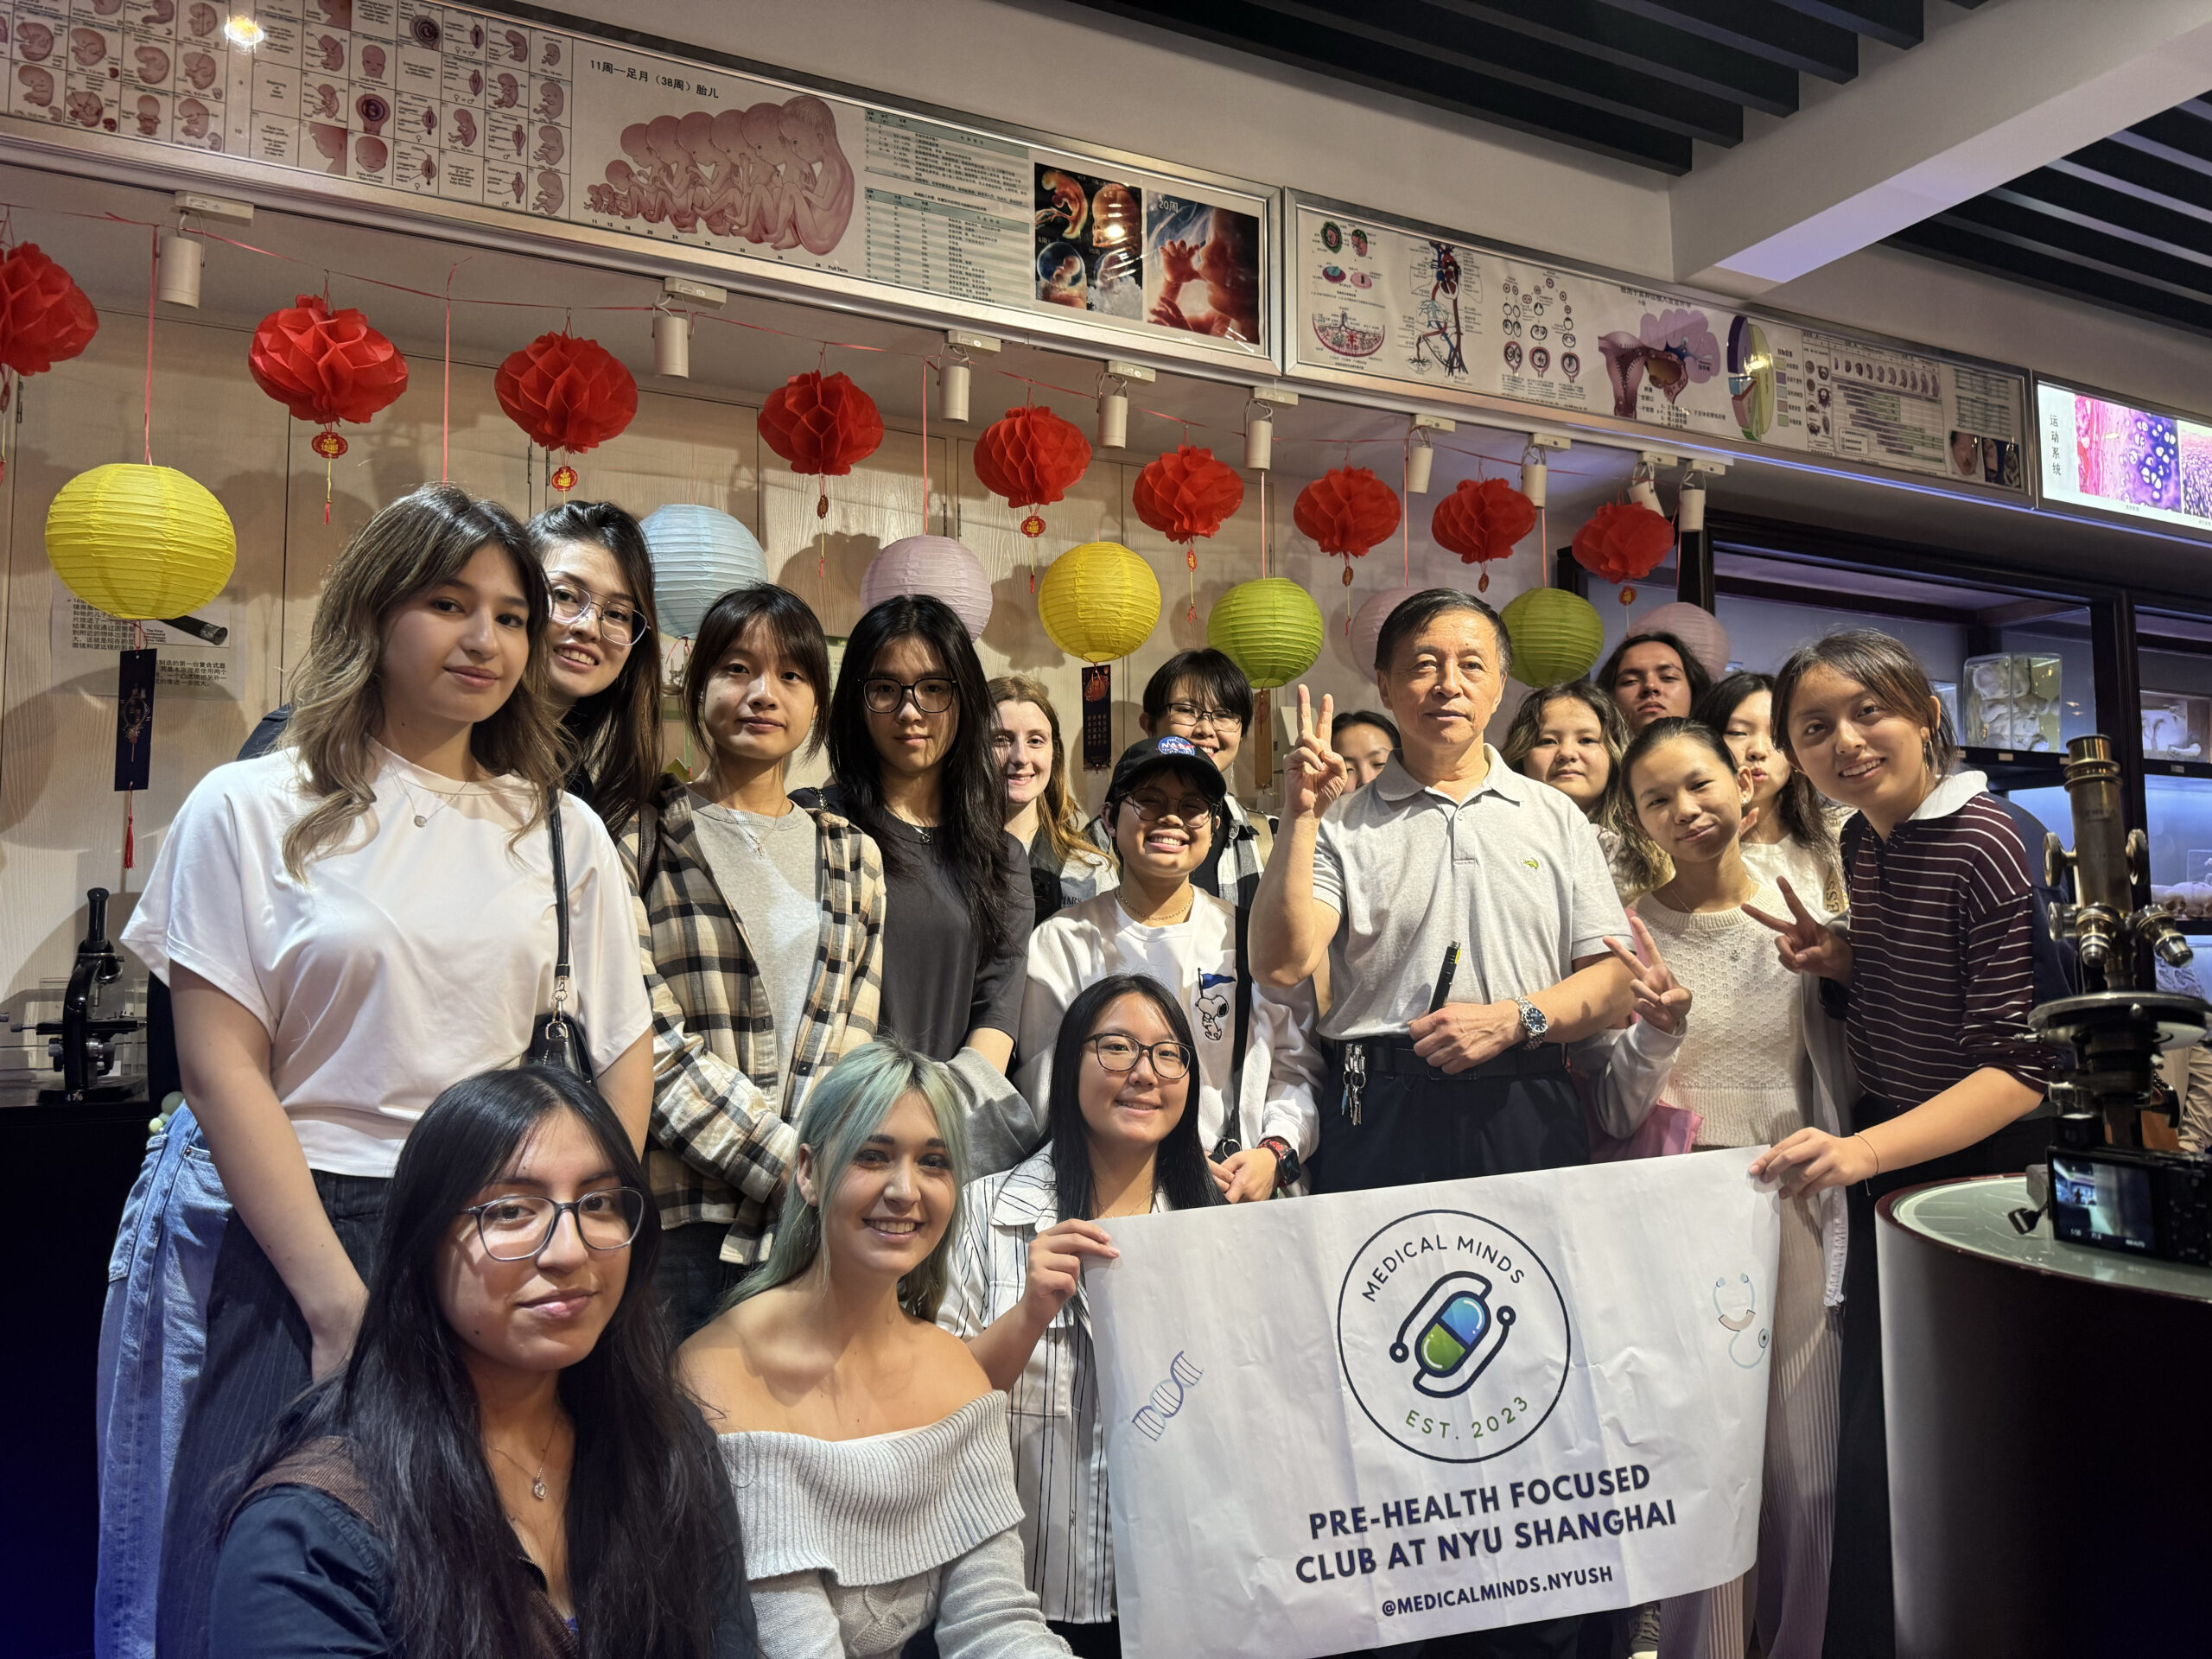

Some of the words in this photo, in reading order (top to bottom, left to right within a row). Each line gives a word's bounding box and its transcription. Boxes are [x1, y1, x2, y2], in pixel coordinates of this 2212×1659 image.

[2050, 414, 2062, 476] 运动系统
[1161, 741, 1192, 753] NASA
[1362, 1234, 1447, 1302] MEDICAL
[1458, 1236, 1524, 1284] MINDS
[1405, 1409, 1459, 1440] EST.
[1471, 1396, 1528, 1439] 2023
[1308, 1485, 1500, 1540] PRE-HEALTH
[1510, 1464, 1650, 1508] FOCUSED
[1295, 1548, 1376, 1584] CLUB
[1388, 1538, 1427, 1570] AT
[1437, 1526, 1503, 1562] NYU
[1514, 1499, 1676, 1549] SHANGHAI
[1382, 1565, 1614, 1618] @MEDICALMINDS.NYUSH
